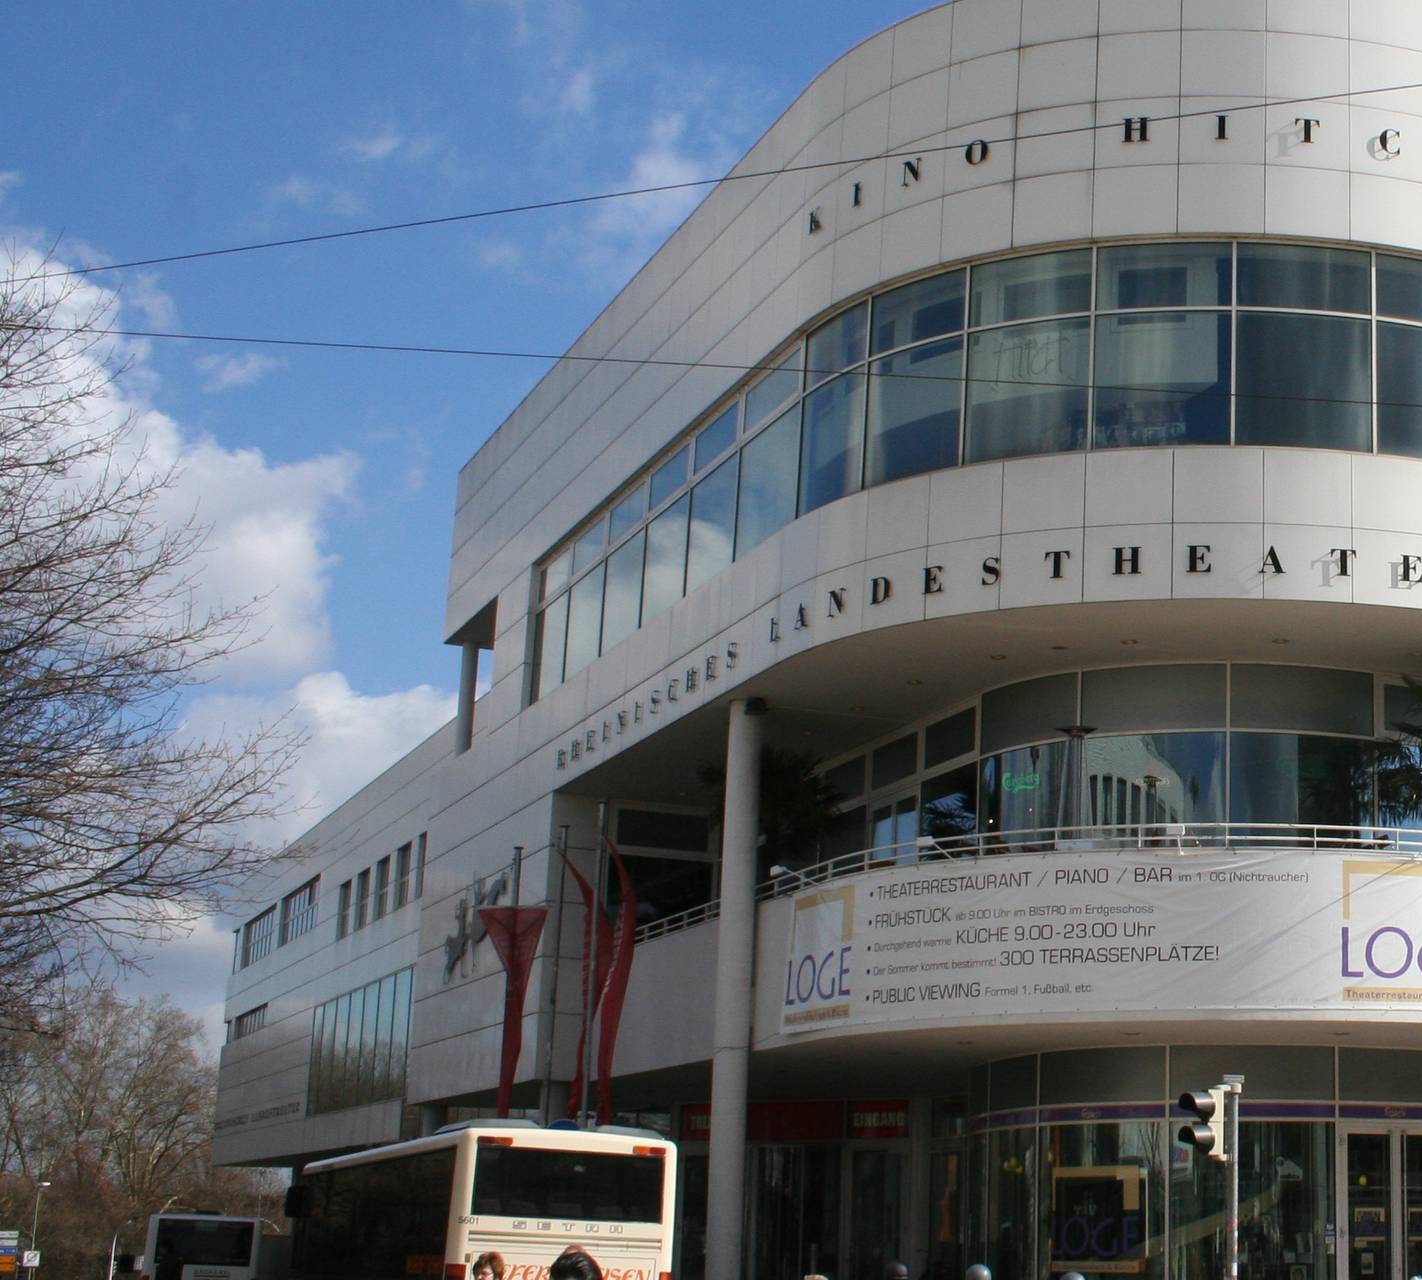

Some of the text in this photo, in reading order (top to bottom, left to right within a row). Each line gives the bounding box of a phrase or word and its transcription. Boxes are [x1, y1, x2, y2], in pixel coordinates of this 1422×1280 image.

[808, 137, 990, 233] KINO
[556, 641, 738, 770] RHEINISCHES
[877, 871, 1032, 901] THEATERRESTAURANT
[1055, 867, 1109, 885] PIANO
[1134, 867, 1172, 883] BAR
[1178, 872, 1191, 881] im
[1209, 872, 1226, 882] OG
[1229, 871, 1309, 883] (Nichtraucher)
[875, 906, 952, 929] FRÜHSTÜCK
[968, 909, 991, 920] 9.00
[1014, 907, 1026, 917] im
[1029, 905, 1066, 916] BISTRO
[1069, 905, 1082, 915] im
[1085, 904, 1154, 917] Erdgeschoss
[956, 926, 1009, 944] KÜCHE
[1123, 921, 1156, 938] Uhr
[888, 964, 918, 974] Sommer
[921, 961, 949, 972] kommt
[951, 957, 996, 970] bestimmt!
[1000, 950, 1034, 967] 300
[1040, 944, 1219, 965] TERRASSENPLÄTZE!
[785, 946, 852, 1006] LOGE
[872, 986, 916, 1004] PUBLIC
[919, 982, 981, 1001] VIEWING
[985, 985, 1018, 996] Formel
[853, 1111, 906, 1128] EINGANG
[1051, 1215, 1140, 1257] LOGE
